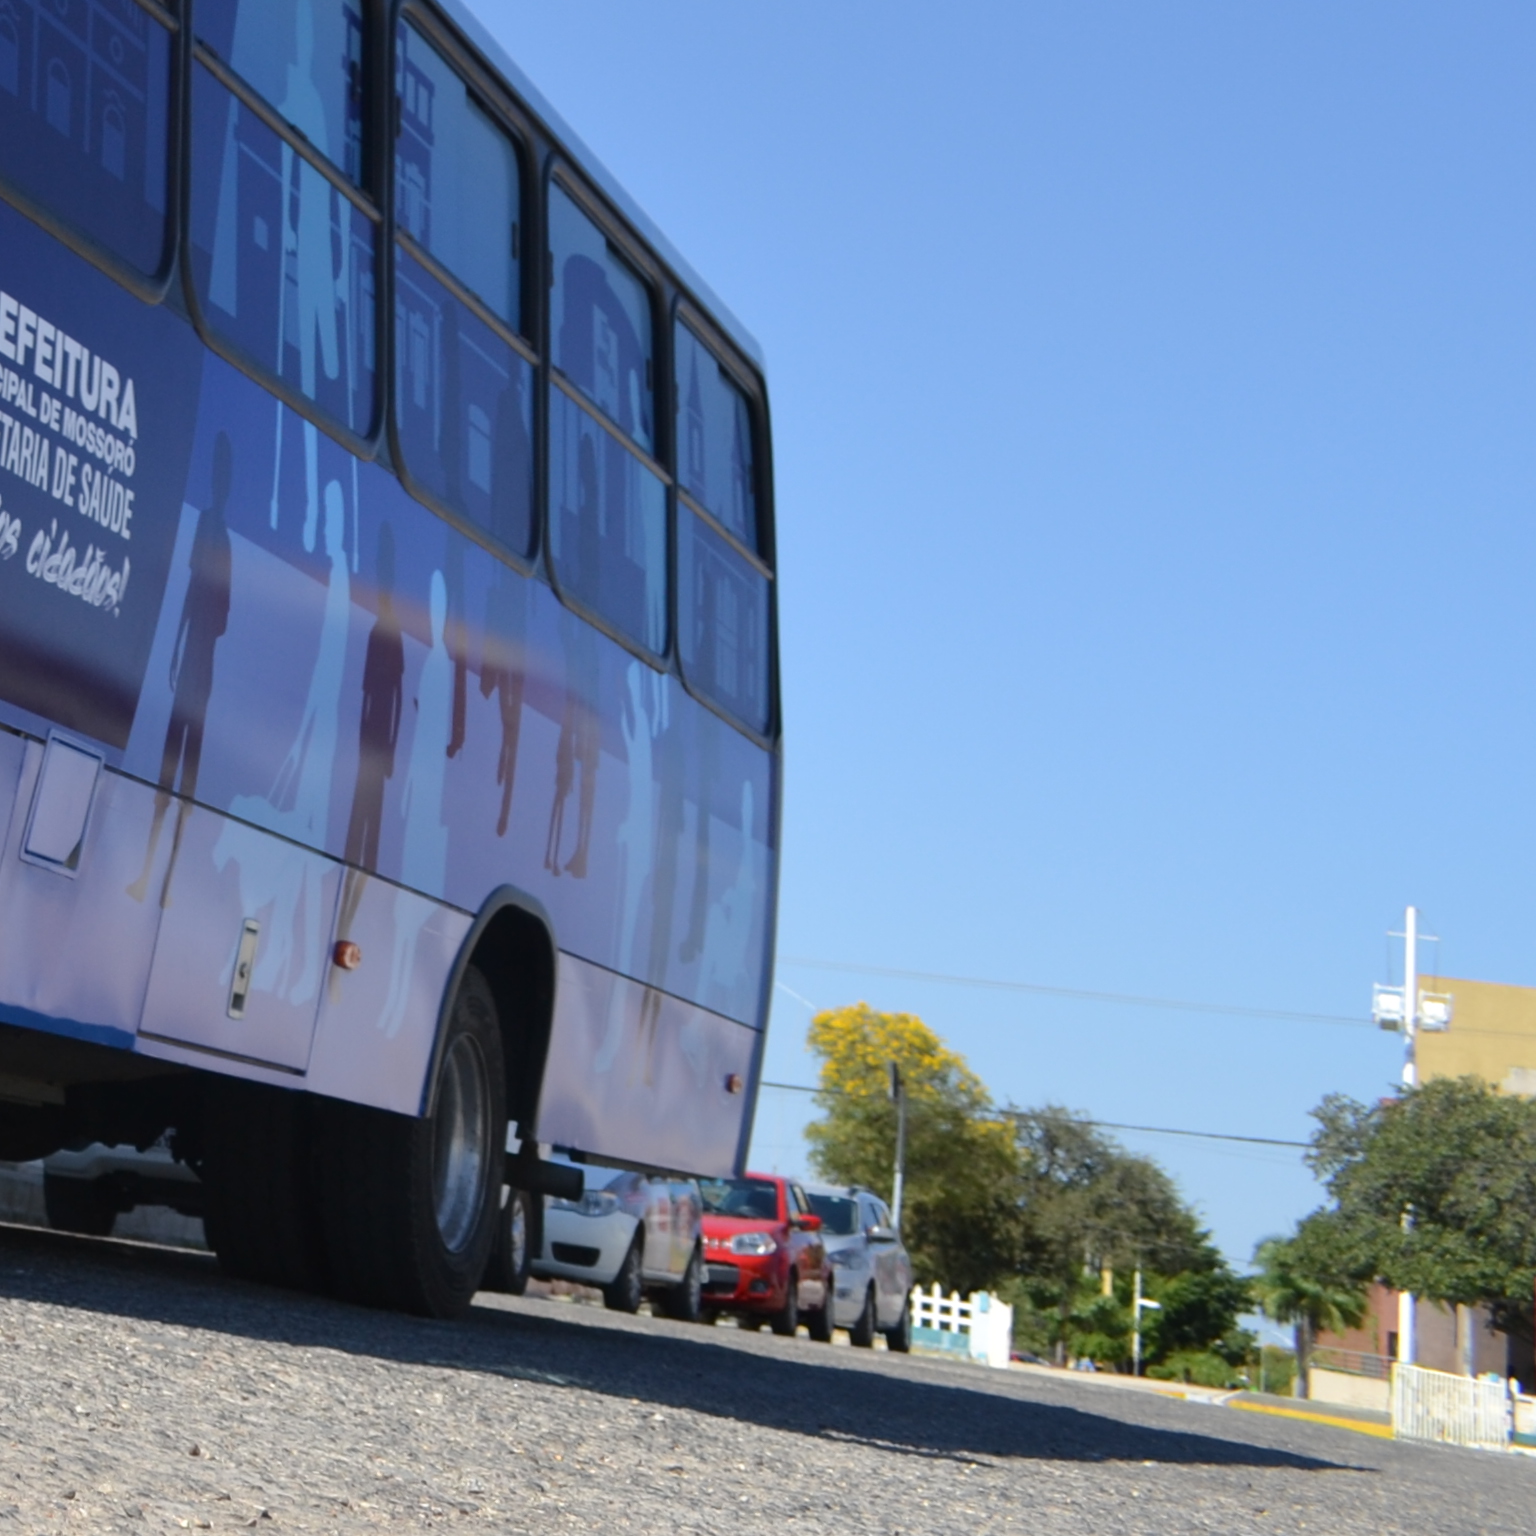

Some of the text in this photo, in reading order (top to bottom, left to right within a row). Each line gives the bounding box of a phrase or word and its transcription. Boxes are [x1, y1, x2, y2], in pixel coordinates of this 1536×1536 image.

[39, 390, 62, 433] DE
[62, 405, 136, 478] MOSSORÓ
[51, 445, 79, 508] DE
[78, 463, 136, 541] SAÚDE
[26, 517, 131, 618] cidadãos!
